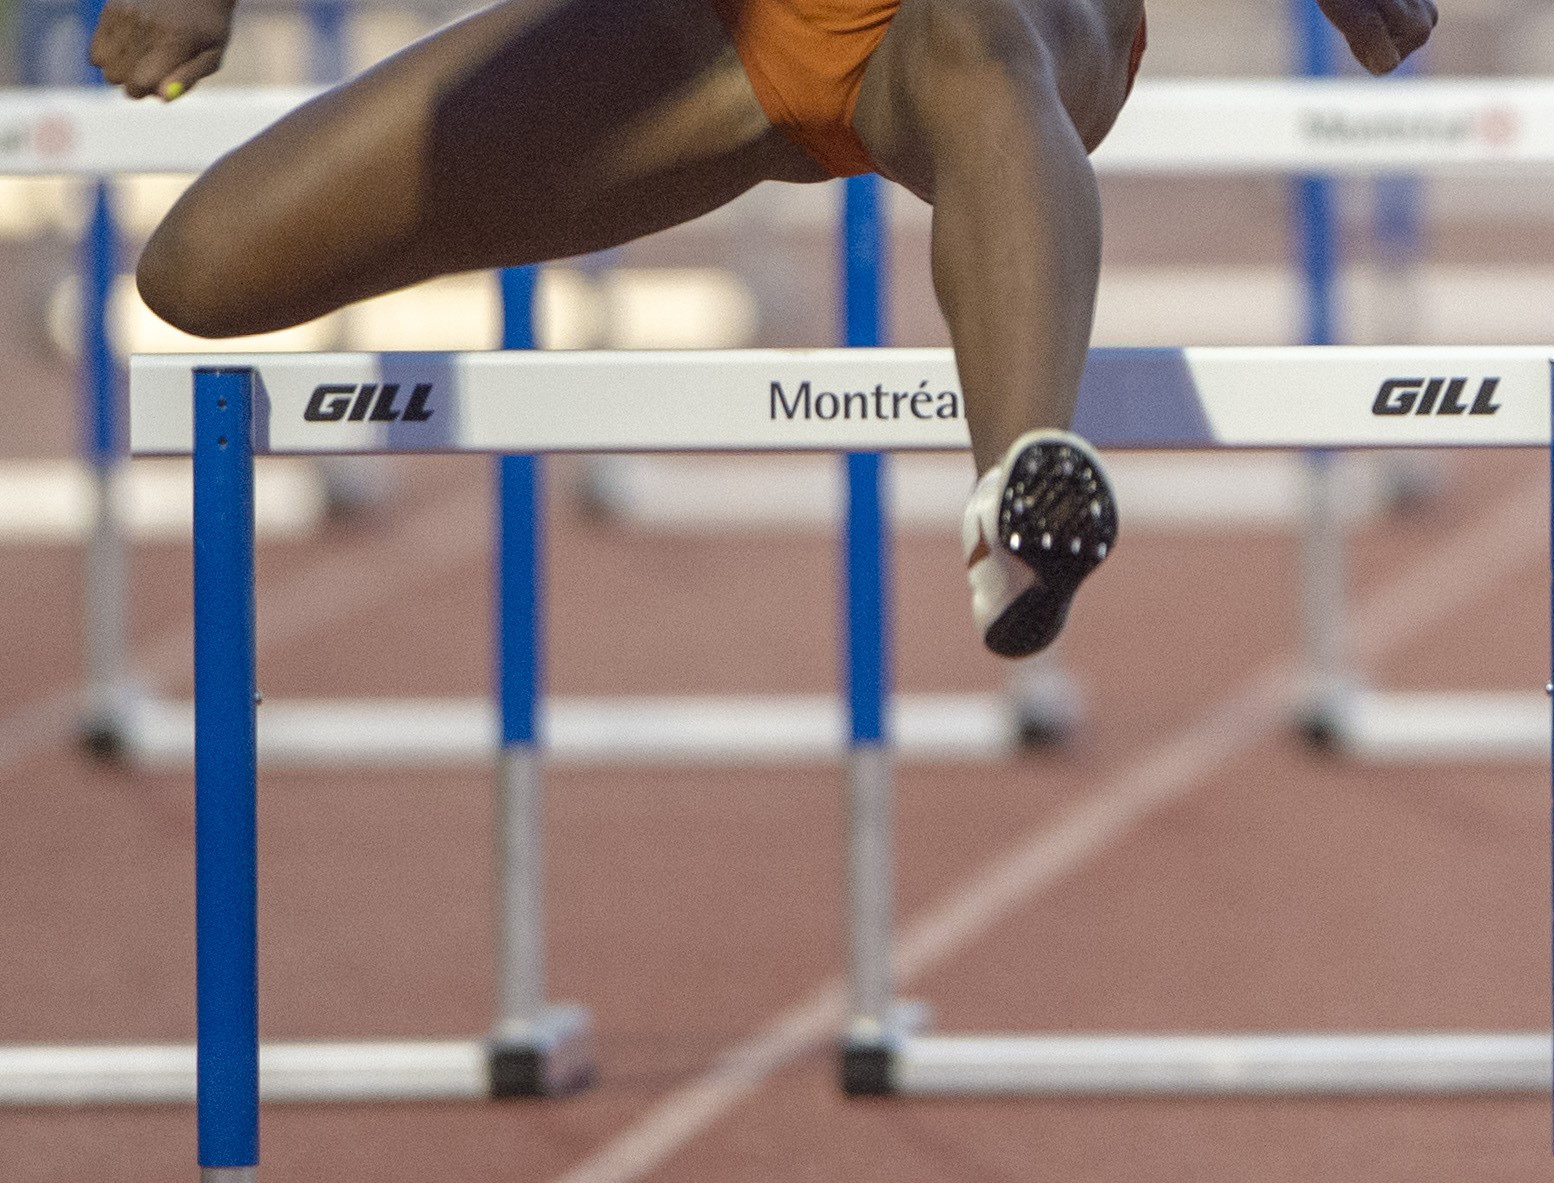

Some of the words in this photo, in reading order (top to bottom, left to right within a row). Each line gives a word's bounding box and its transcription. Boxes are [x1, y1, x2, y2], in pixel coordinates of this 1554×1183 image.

[303, 382, 435, 422] GILL
[769, 379, 967, 420] Montréa
[1371, 376, 1502, 416] GILL
